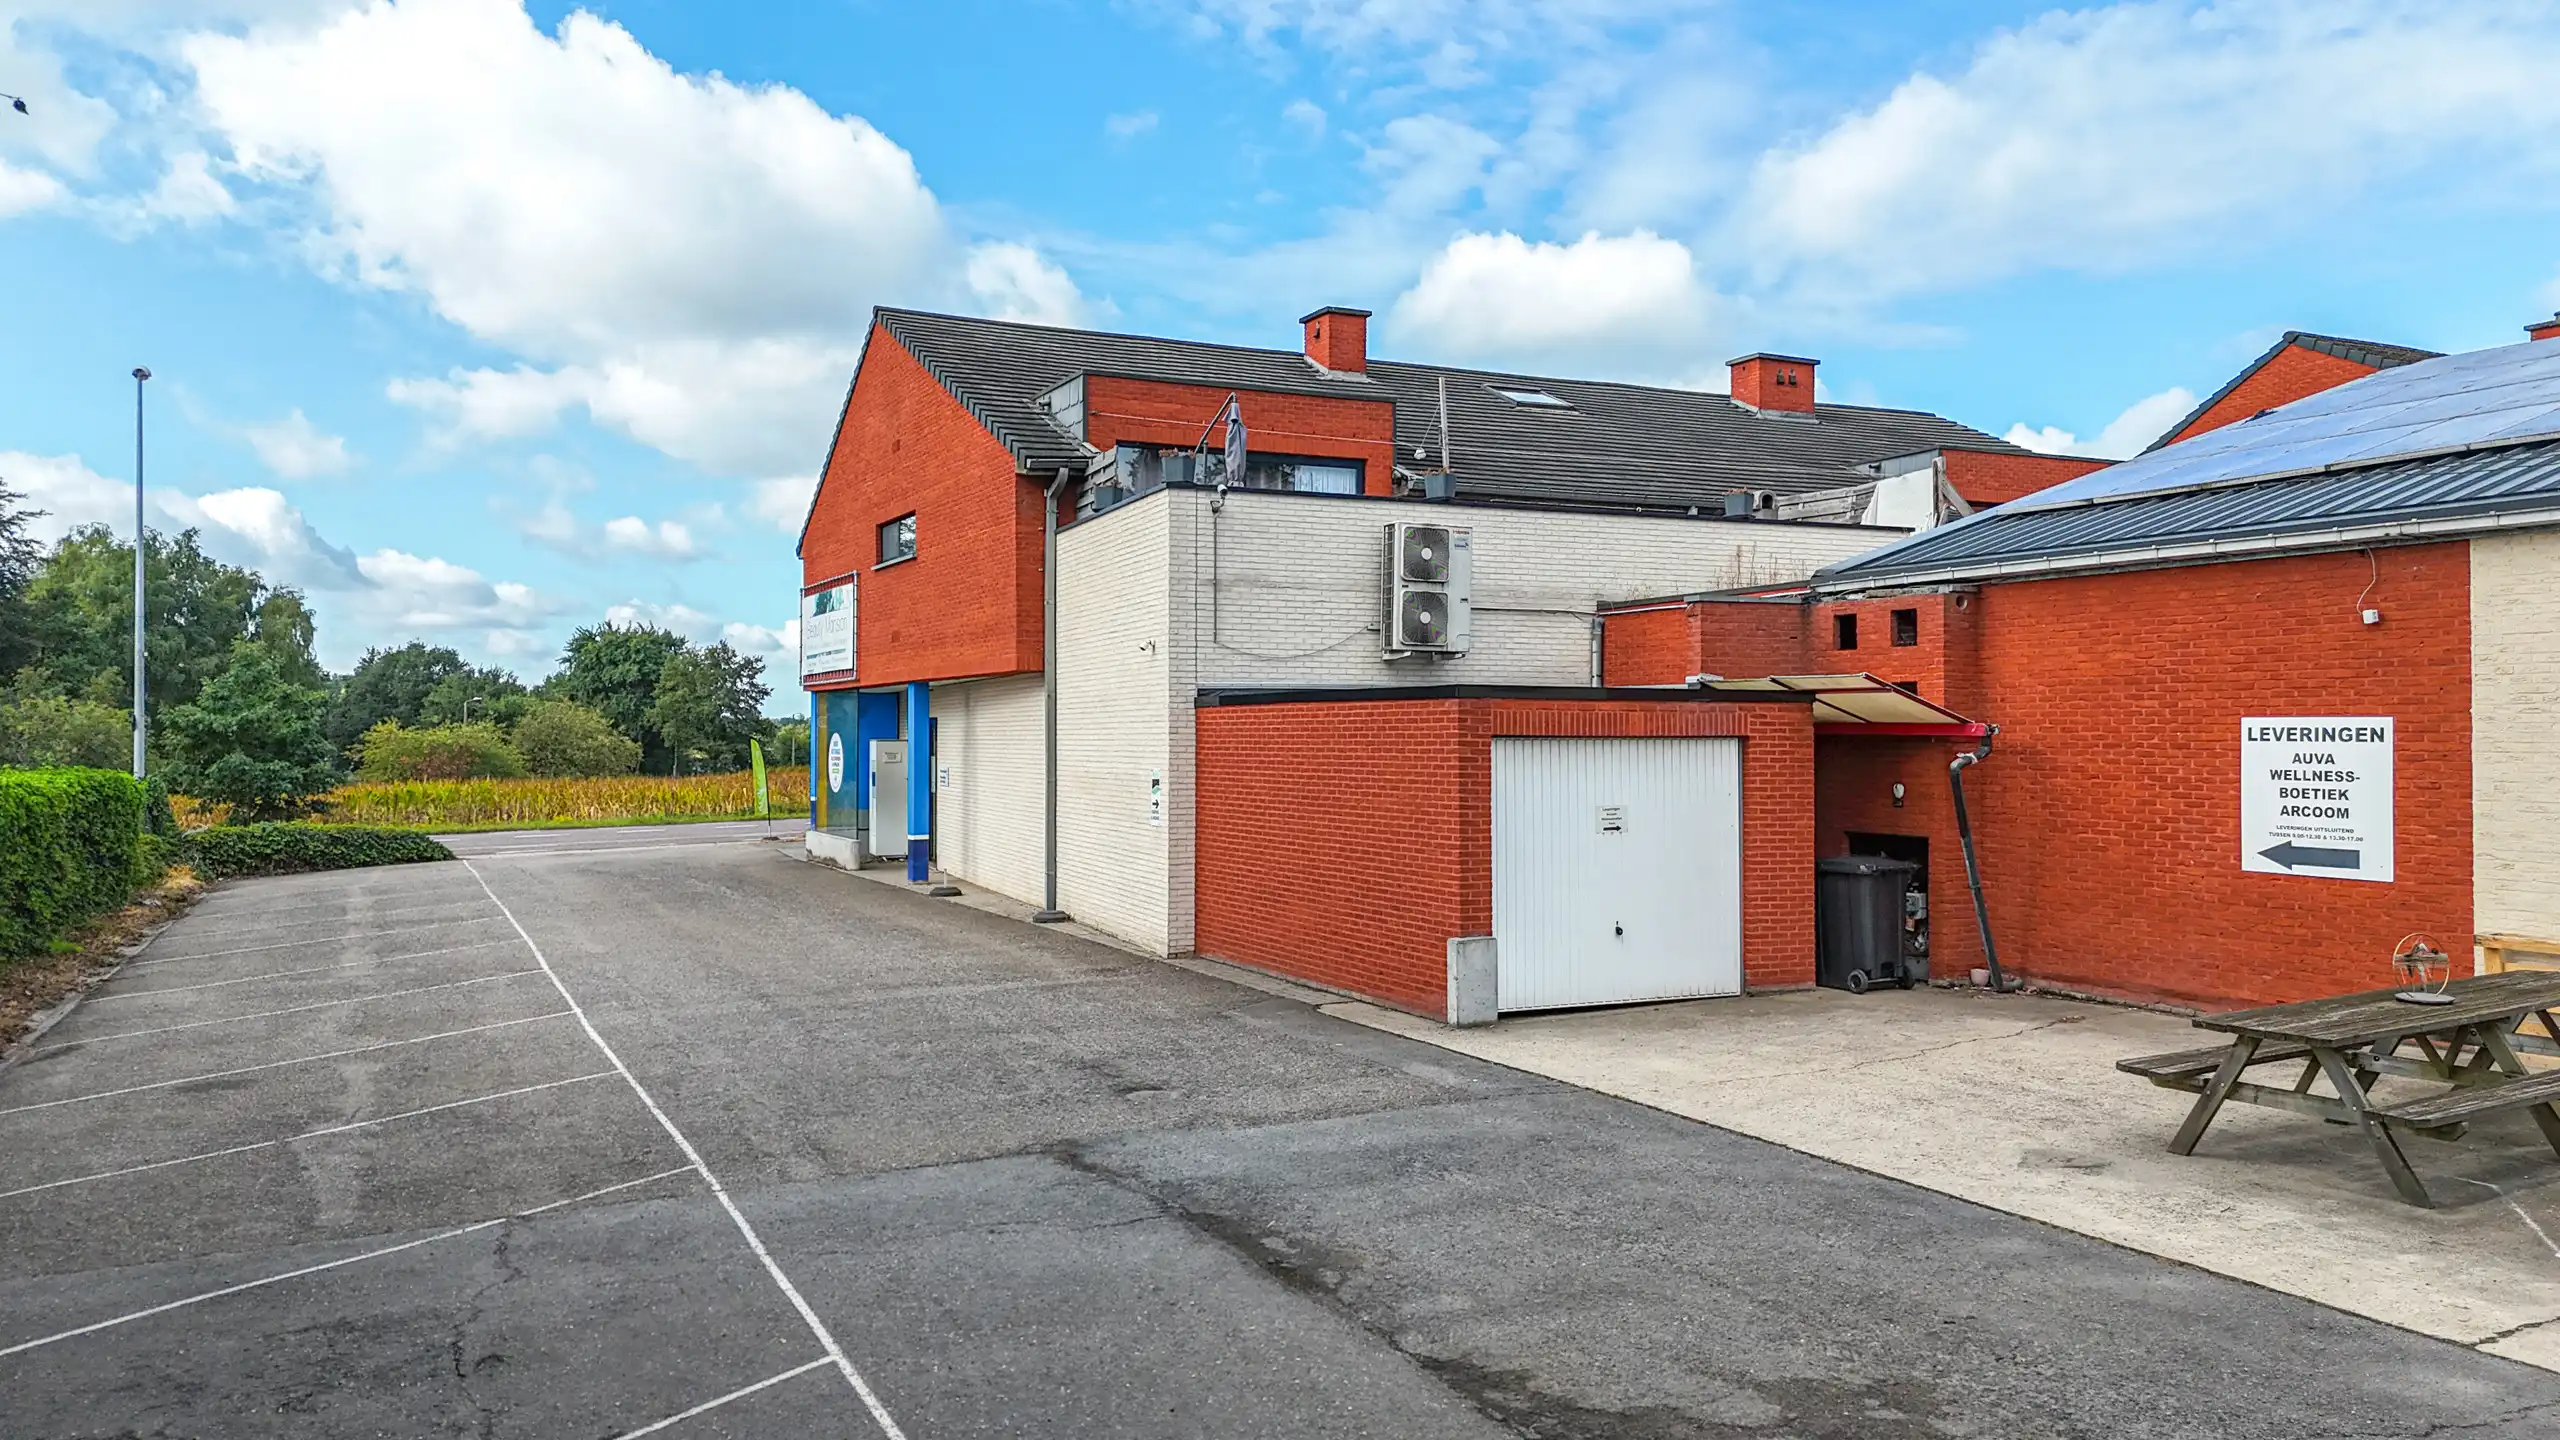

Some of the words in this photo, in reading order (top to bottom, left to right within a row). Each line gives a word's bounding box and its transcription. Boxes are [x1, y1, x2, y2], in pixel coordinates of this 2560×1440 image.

[2247, 727, 2385, 743] LEVERINGEN
[2292, 753, 2336, 765] AUVA
[2270, 769, 2361, 783] WELLNESS-
[2279, 787, 2350, 801] BOETIEK
[2280, 805, 2350, 819] ARCOOM
[2313, 826, 2355, 834] UITSLUITEND
